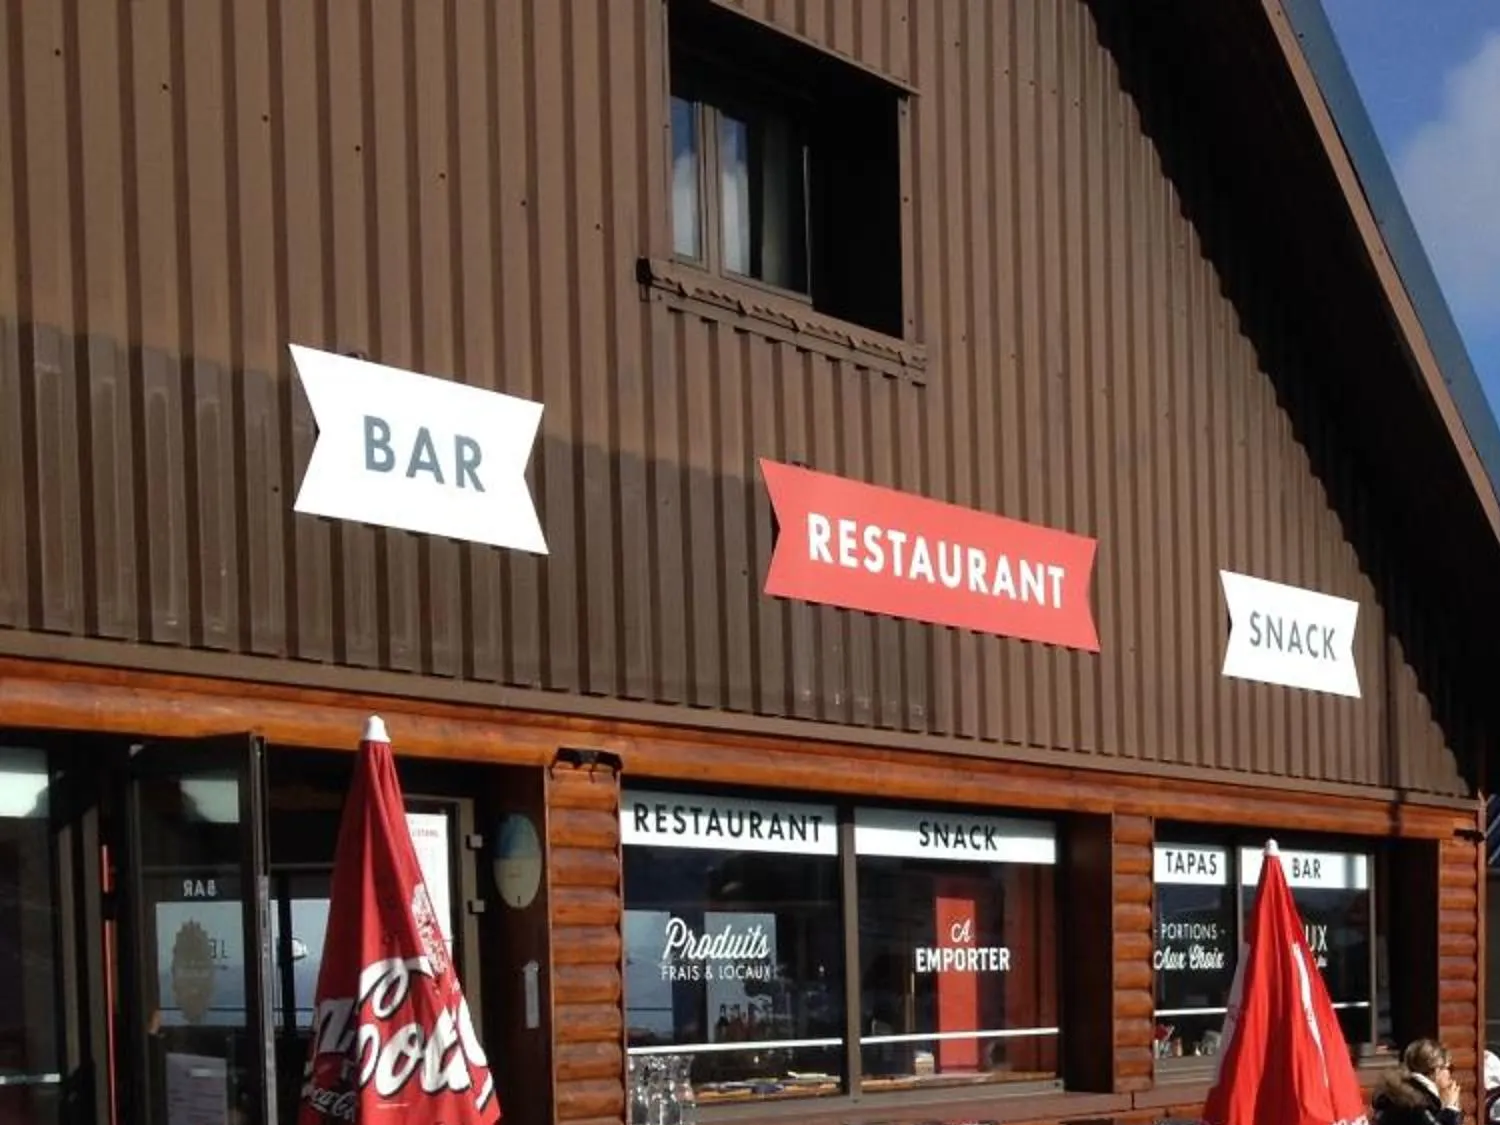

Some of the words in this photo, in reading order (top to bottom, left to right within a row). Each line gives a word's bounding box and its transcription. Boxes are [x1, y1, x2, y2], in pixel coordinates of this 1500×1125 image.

[363, 415, 486, 493] BAR
[807, 512, 1065, 609] RESTAURANT
[1249, 611, 1337, 661] SNACK
[633, 803, 823, 843] RESTAURANT
[918, 821, 999, 852] SNACK
[1165, 851, 1217, 875] TAPAS
[1292, 858, 1321, 879] BAR
[662, 917, 771, 960] Produits
[1161, 923, 1217, 940] PORTIONS
[661, 964, 700, 981] FRAIS
[704, 964, 714, 980] &
[719, 964, 772, 982] LOCAUX
[915, 947, 1011, 973] EMPORTER
